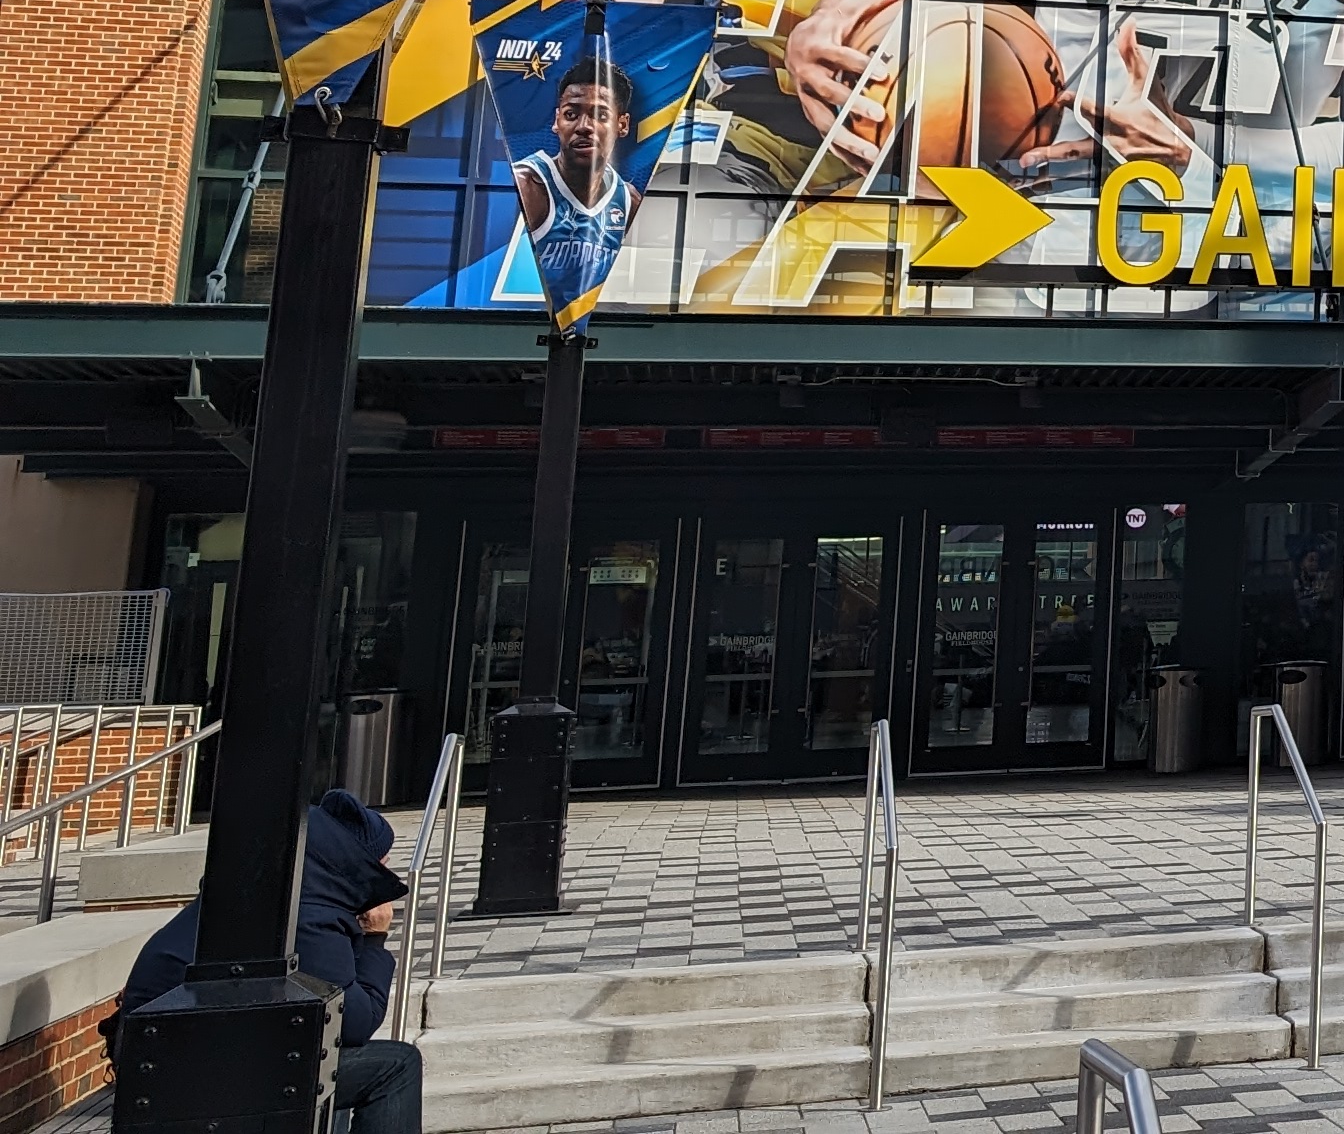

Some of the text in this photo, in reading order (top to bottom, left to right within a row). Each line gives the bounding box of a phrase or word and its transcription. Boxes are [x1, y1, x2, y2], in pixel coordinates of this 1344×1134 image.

[496, 38, 563, 62] INDY 24
[1127, 513, 1146, 523] TNT
